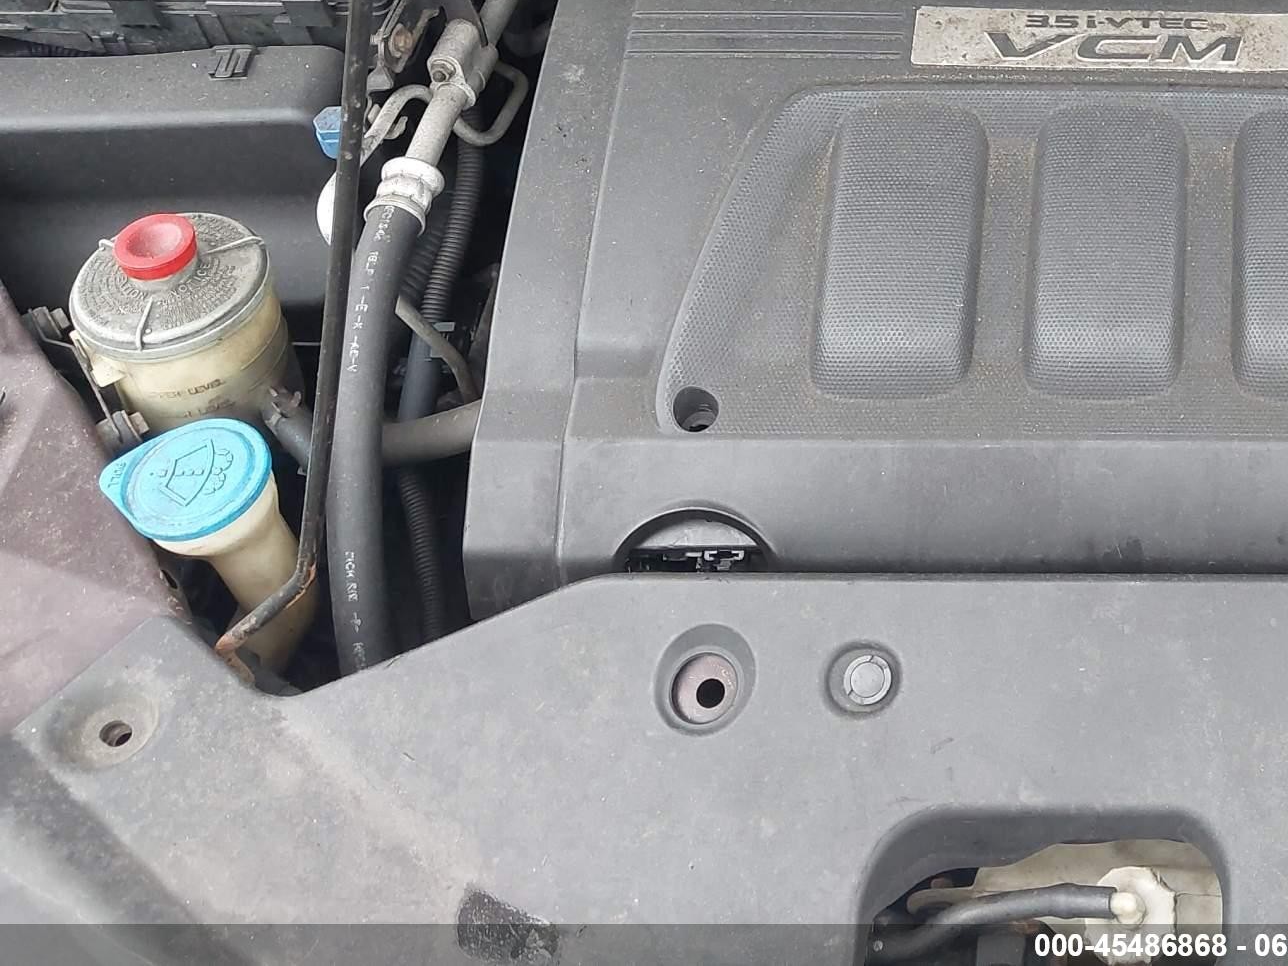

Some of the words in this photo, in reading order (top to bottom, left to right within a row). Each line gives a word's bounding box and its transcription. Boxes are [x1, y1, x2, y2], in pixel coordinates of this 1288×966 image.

[1086, 15, 1209, 30] i-VTEC
[984, 31, 1246, 66] VCM
[170, 263, 211, 299] NOTICE
[107, 462, 127, 488] PULL
